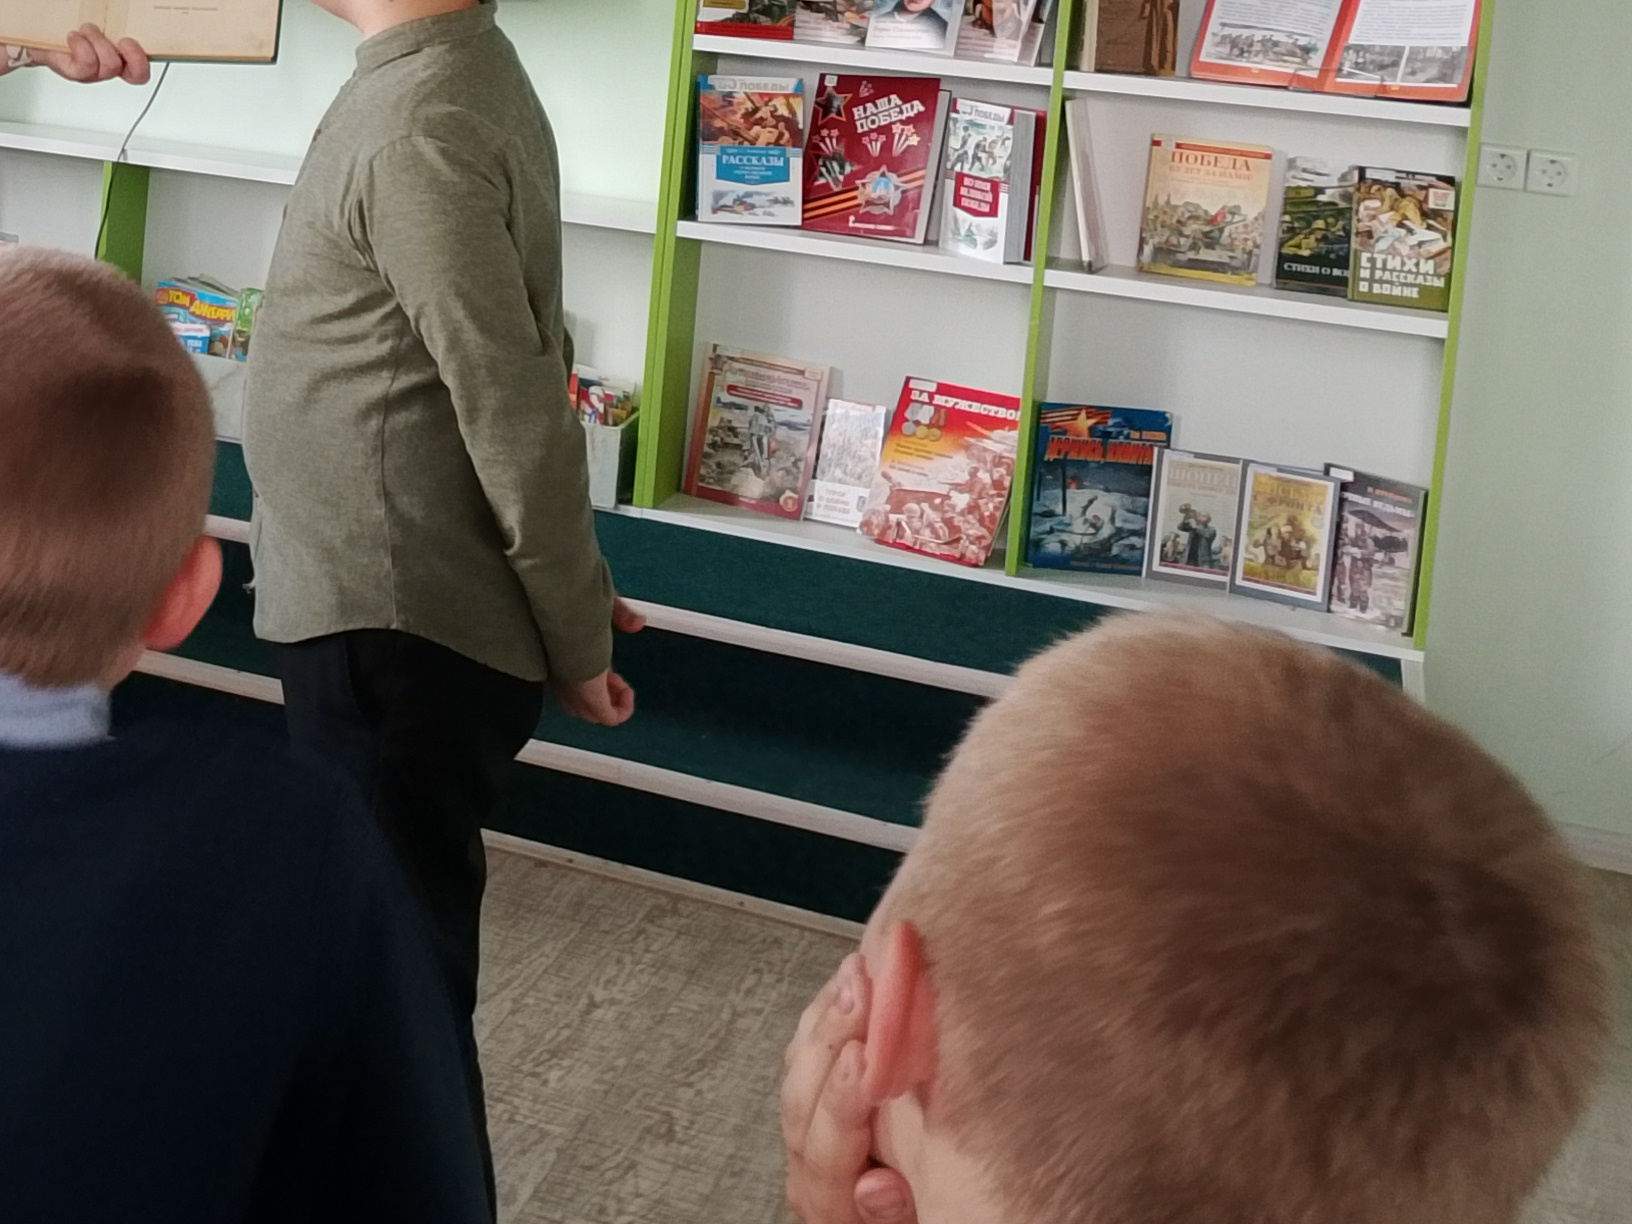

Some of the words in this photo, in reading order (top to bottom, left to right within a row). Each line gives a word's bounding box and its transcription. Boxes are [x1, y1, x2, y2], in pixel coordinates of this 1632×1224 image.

[852, 93, 903, 120] НАША
[855, 100, 926, 133] ПОБЕДА
[722, 155, 784, 166] РАССКАЗЫ
[1171, 151, 1251, 171] ПОБЕДА
[1283, 262, 1320, 274] СТИХИ
[1360, 252, 1435, 275] СТИХИ
[1359, 268, 1370, 279] И
[1375, 269, 1445, 287] РАССКАЗЫ
[1358, 281, 1369, 293] О
[1372, 282, 1420, 298] ВОЙНЕ
